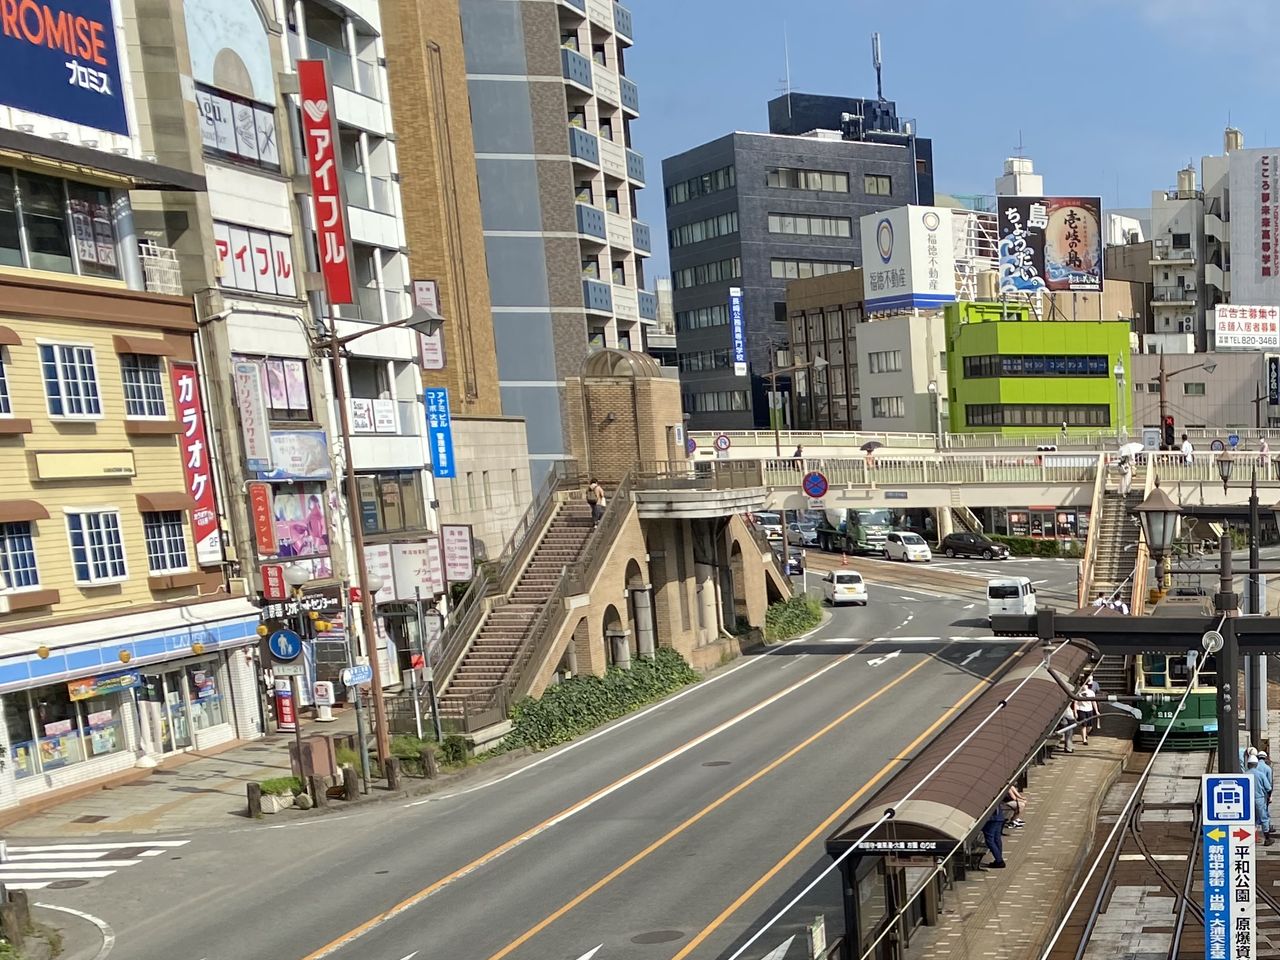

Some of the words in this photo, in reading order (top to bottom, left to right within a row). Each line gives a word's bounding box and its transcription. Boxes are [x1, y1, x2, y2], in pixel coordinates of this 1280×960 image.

[65, 60, 113, 96] プロミス
[310, 128, 344, 264] アイフル
[215, 239, 291, 279] アイフル
[1218, 307, 1277, 320] 広告主募集中
[1230, 336, 1241, 344] TEL
[1241, 336, 1278, 345] 820-3468
[178, 374, 207, 501] カラオケ
